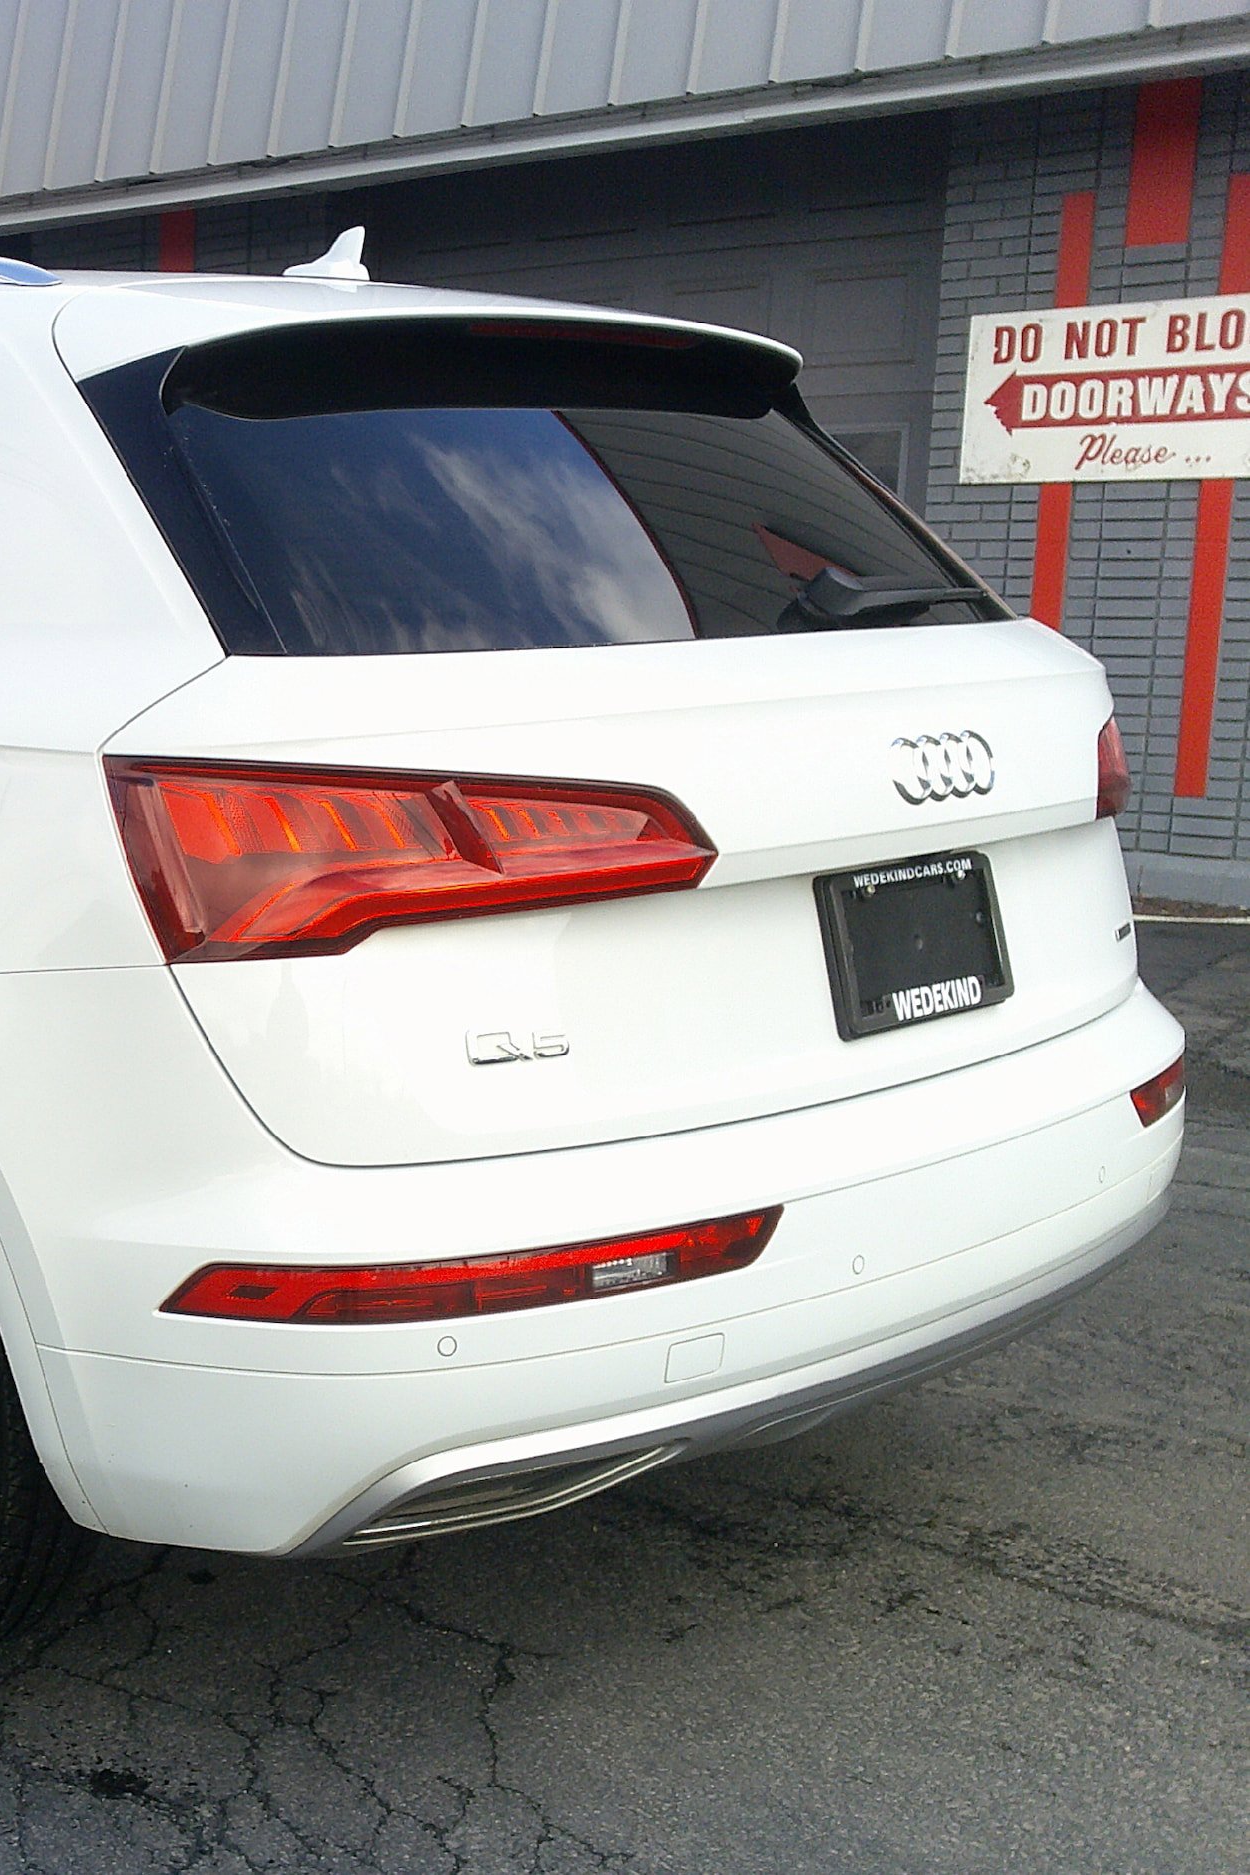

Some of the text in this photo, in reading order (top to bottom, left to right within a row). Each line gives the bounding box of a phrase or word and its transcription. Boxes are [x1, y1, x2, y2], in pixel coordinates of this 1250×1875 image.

[993, 308, 1250, 365] DO NOT BLO
[1021, 371, 1250, 421] DOORWAYS
[1075, 433, 1176, 470] Please
[853, 857, 972, 888] WEDEKINDCARS.COM
[892, 975, 982, 1021] WEDEKIND
[465, 1029, 570, 1067] Q5
